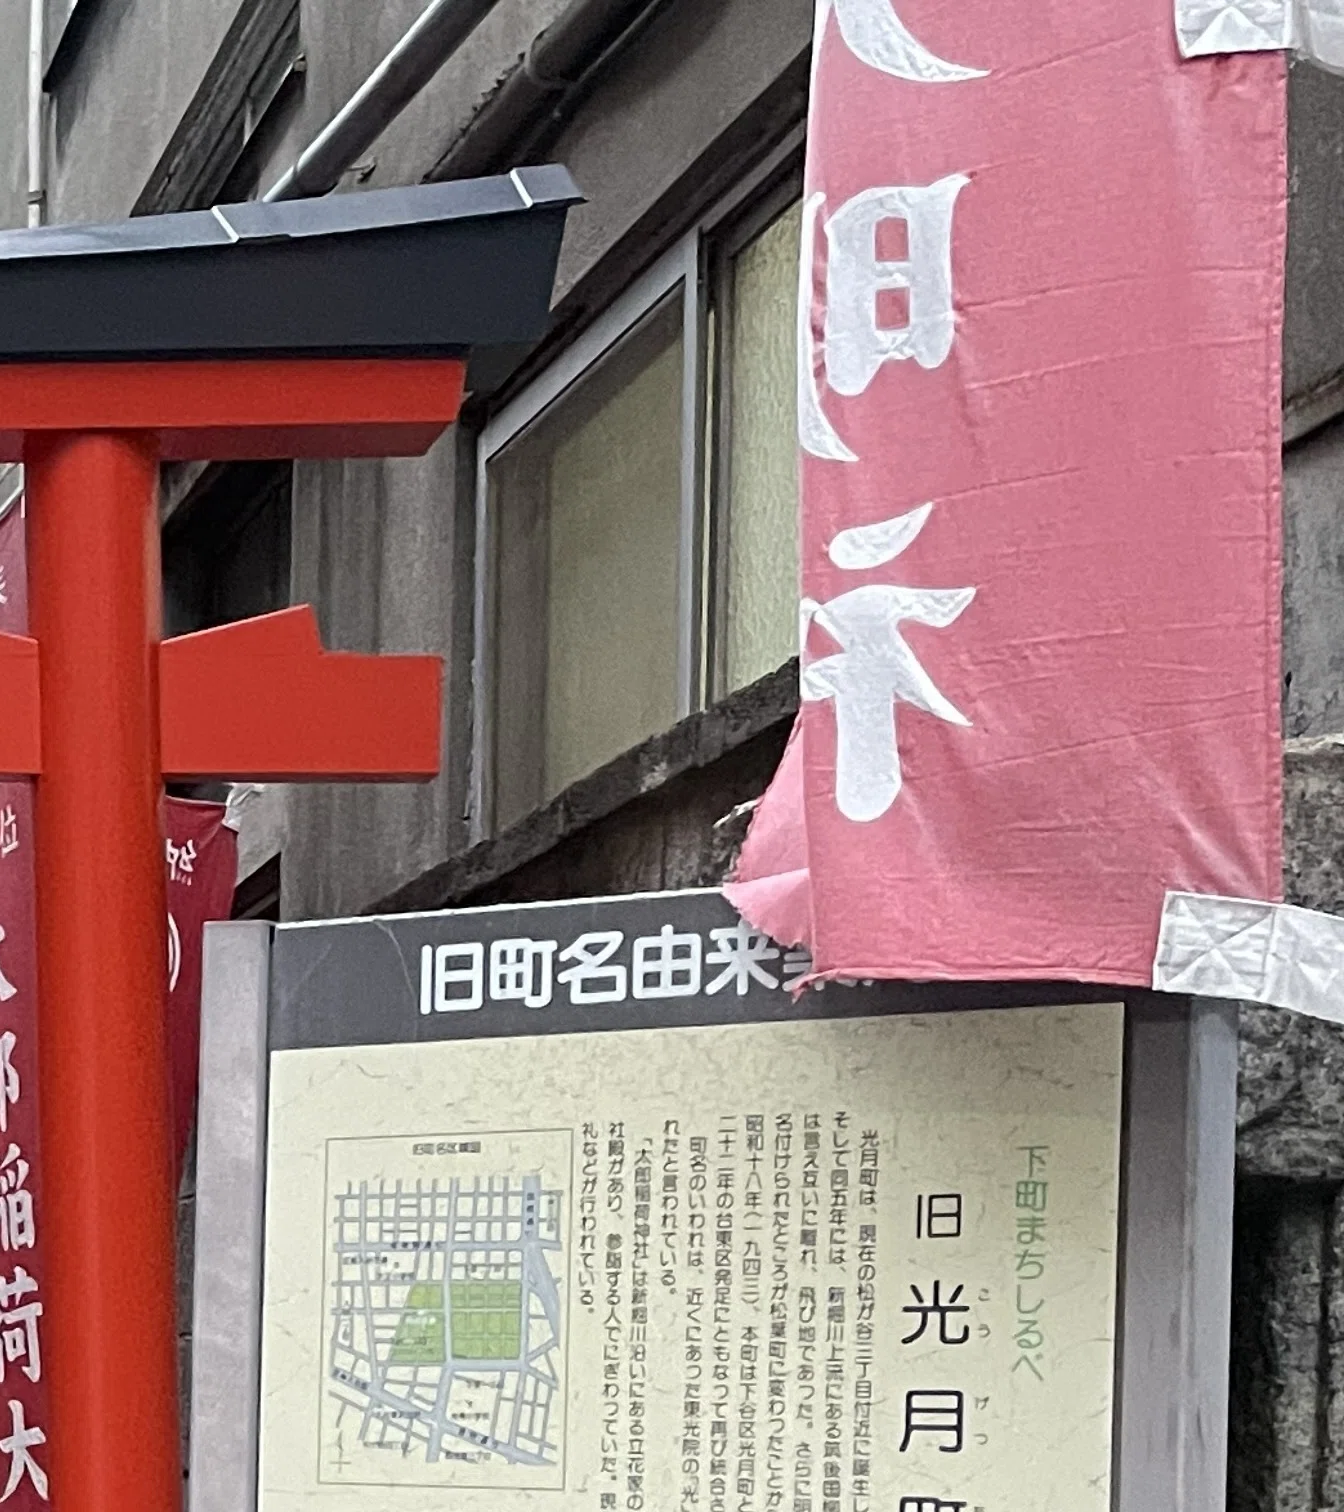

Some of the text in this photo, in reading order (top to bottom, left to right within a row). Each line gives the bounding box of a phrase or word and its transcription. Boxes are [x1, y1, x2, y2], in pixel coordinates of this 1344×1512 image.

[420, 924, 874, 1016] 旧町名由来
[1012, 1145, 1050, 1382] 下町まちしるべ
